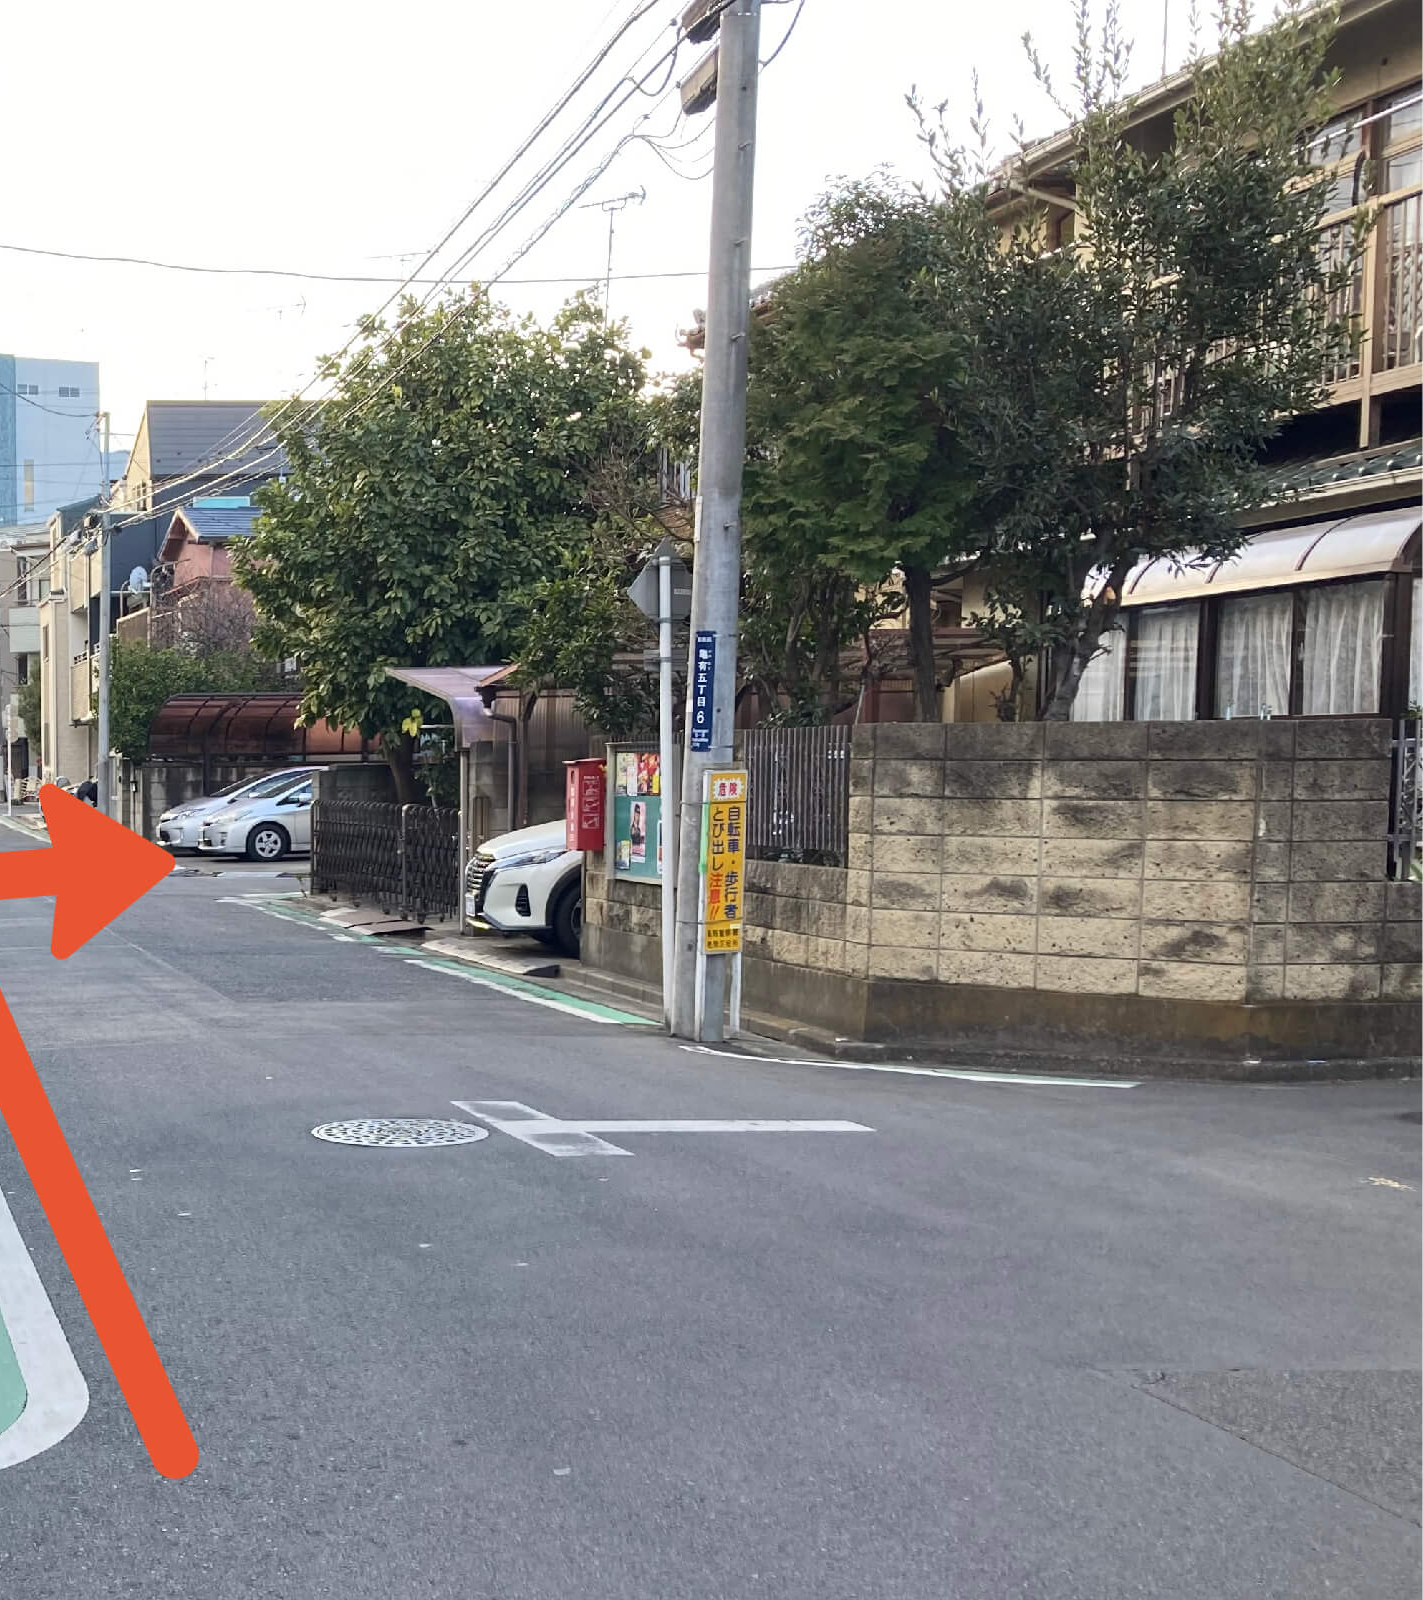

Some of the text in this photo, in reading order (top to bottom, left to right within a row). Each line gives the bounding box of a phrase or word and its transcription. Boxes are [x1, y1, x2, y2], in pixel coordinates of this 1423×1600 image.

[718, 782, 738, 797] 危険
[724, 805, 741, 919] 自転車・歩行者
